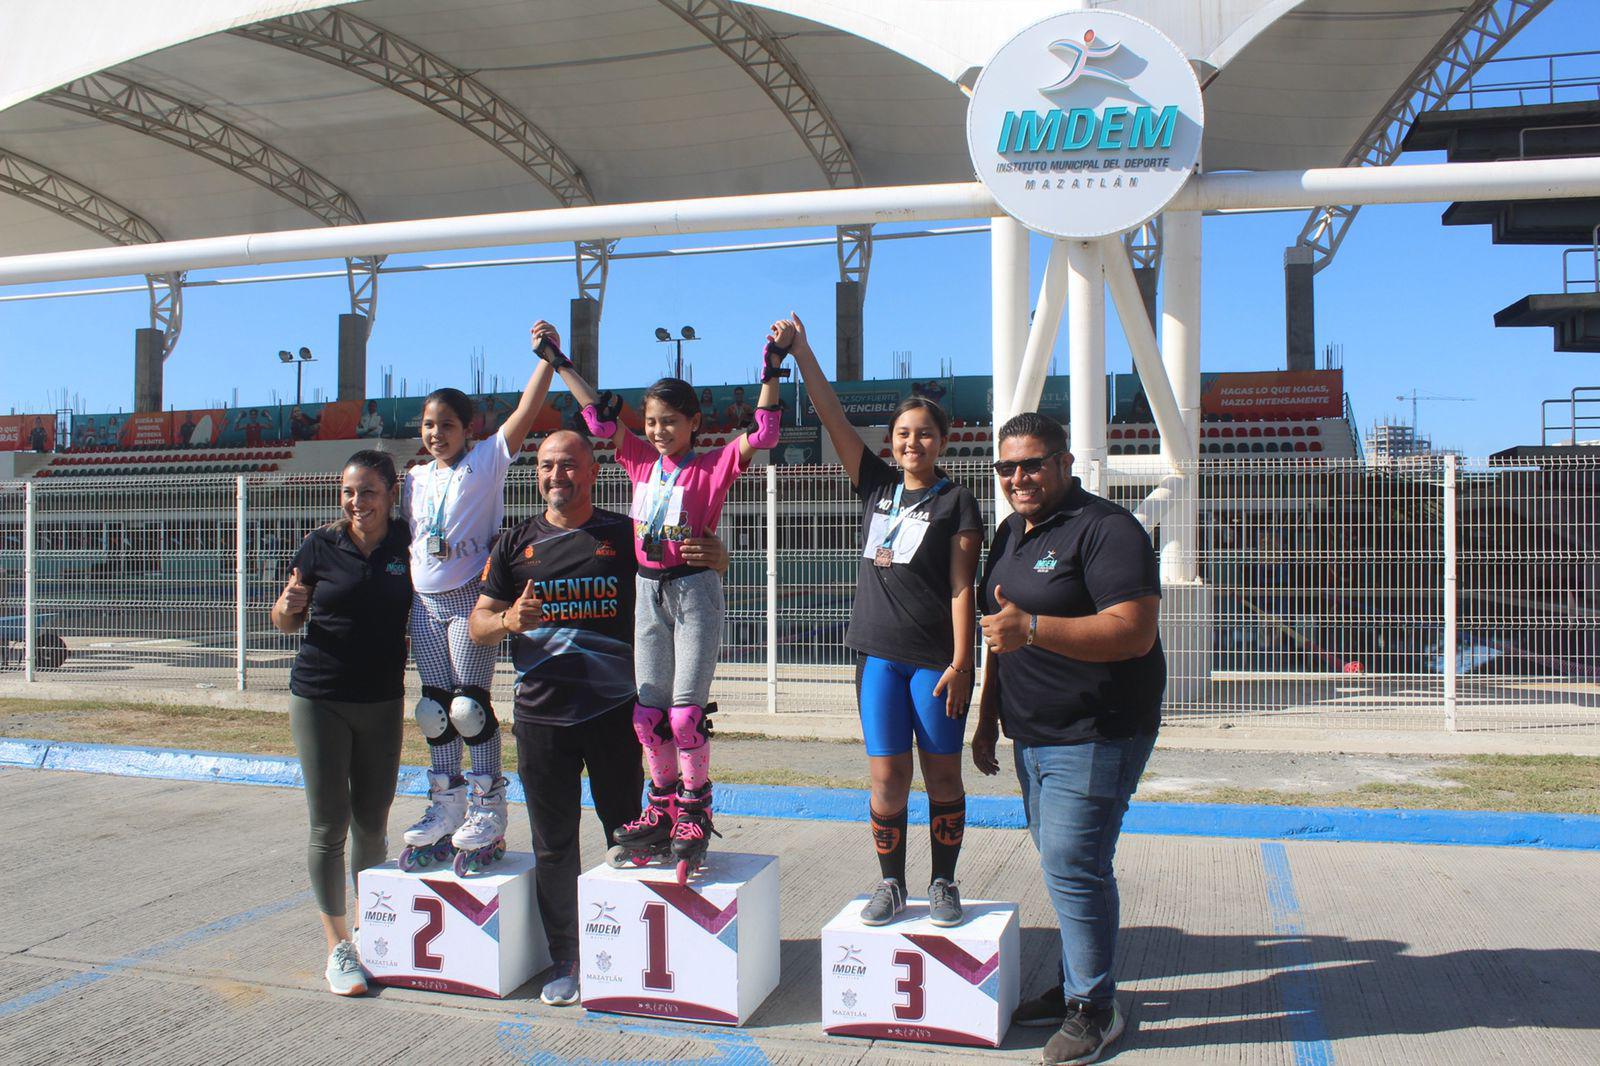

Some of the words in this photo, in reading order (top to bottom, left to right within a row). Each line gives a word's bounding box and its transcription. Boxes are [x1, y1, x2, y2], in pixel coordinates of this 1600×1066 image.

[997, 105, 1179, 154] IMDEM
[996, 162, 1048, 173] INSTITUTO
[1049, 160, 1100, 171] MUNICIPAL
[1103, 158, 1121, 169] DEL
[1124, 157, 1170, 168] DEPORTE
[1024, 175, 1140, 190] MAZATLÁN
[1220, 387, 1254, 395] HAGAS
[1255, 386, 1268, 394] LO
[1270, 386, 1291, 395] QUE
[842, 402, 896, 413] VENCIBLE
[1220, 398, 1254, 407] HAZLO
[1255, 396, 1329, 405] INTENSAMENTE
[532, 576, 619, 601] EVENTOS
[539, 599, 618, 622] SPECIALES
[364, 910, 397, 923] IMDEM
[412, 895, 445, 972] 2
[585, 922, 621, 935] IMDEM
[641, 902, 674, 992] 1
[832, 963, 867, 975] IMDEM
[586, 973, 623, 983] MAZATLÁN
[893, 950, 925, 1021] 3
